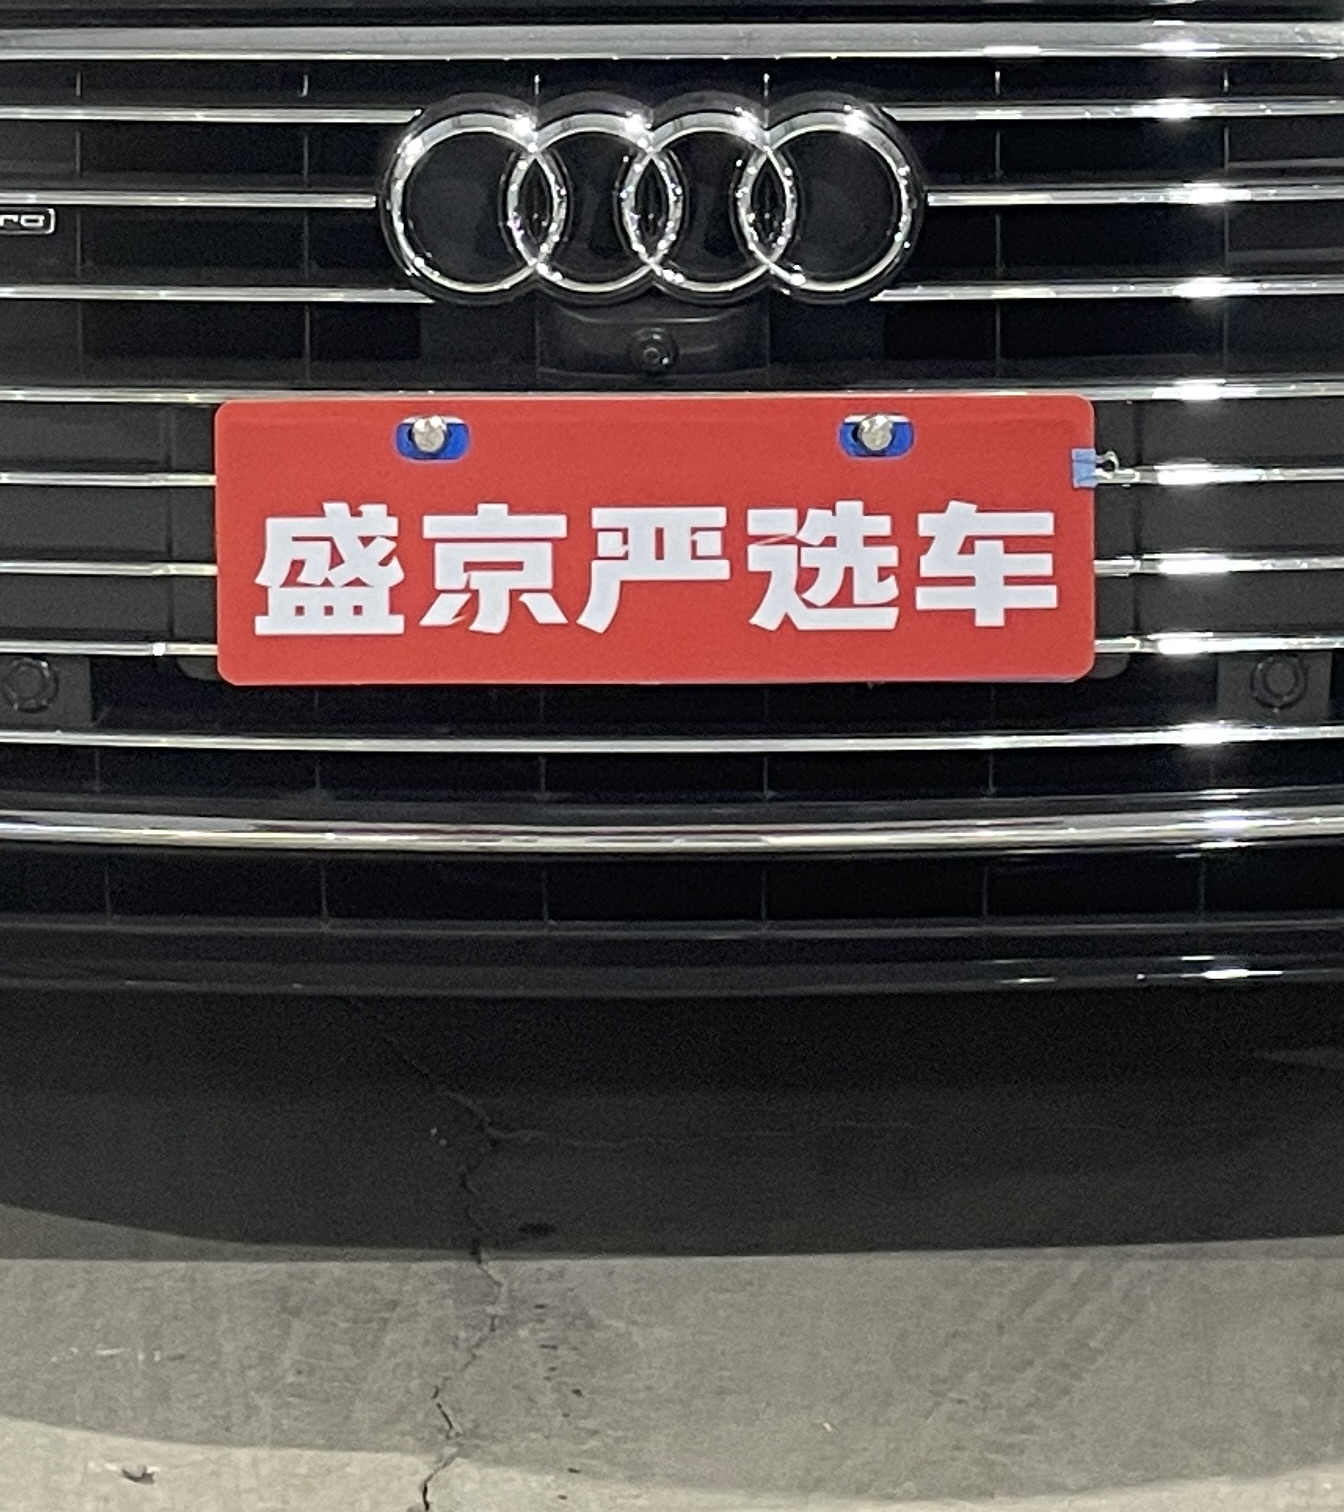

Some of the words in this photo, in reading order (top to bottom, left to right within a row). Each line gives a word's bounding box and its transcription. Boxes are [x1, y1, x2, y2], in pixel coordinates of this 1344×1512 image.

[255, 500, 1058, 636] 盛京严选车
